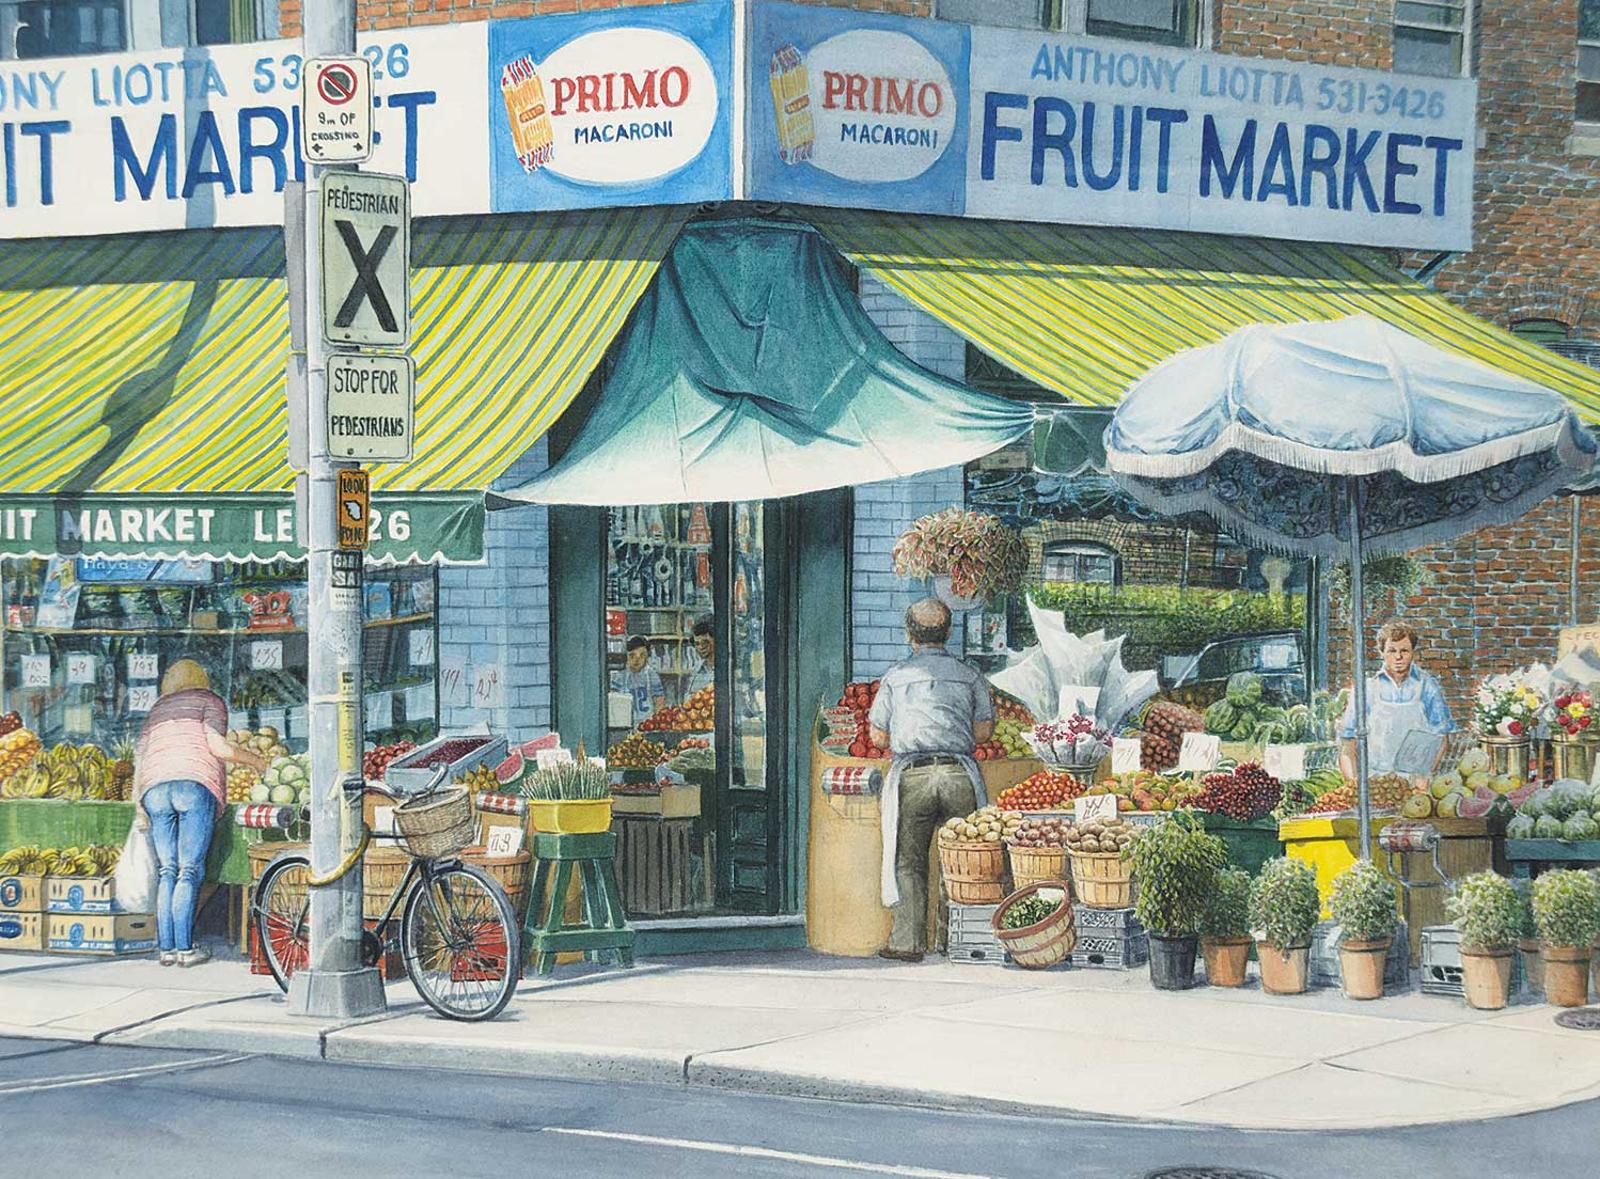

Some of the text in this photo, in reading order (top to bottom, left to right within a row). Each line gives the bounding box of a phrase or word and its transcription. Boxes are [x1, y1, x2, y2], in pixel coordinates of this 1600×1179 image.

[91, 60, 228, 107] LIOTTA
[551, 66, 690, 116] PRIMO
[823, 70, 943, 118] PRIMO
[1031, 43, 1445, 119] ANTHONY LIOTTA 531-3426
[340, 112, 356, 125] OF
[574, 121, 673, 144] MACARONI
[840, 124, 937, 149] MACARONI
[980, 91, 1463, 216] FRUIT MARKET
[327, 188, 399, 215] PEDESTRIAN
[333, 219, 399, 333] X
[334, 367, 399, 395] STOP FOR
[331, 415, 404, 438] PEDESTRIANS
[62, 508, 215, 543] MARKET
